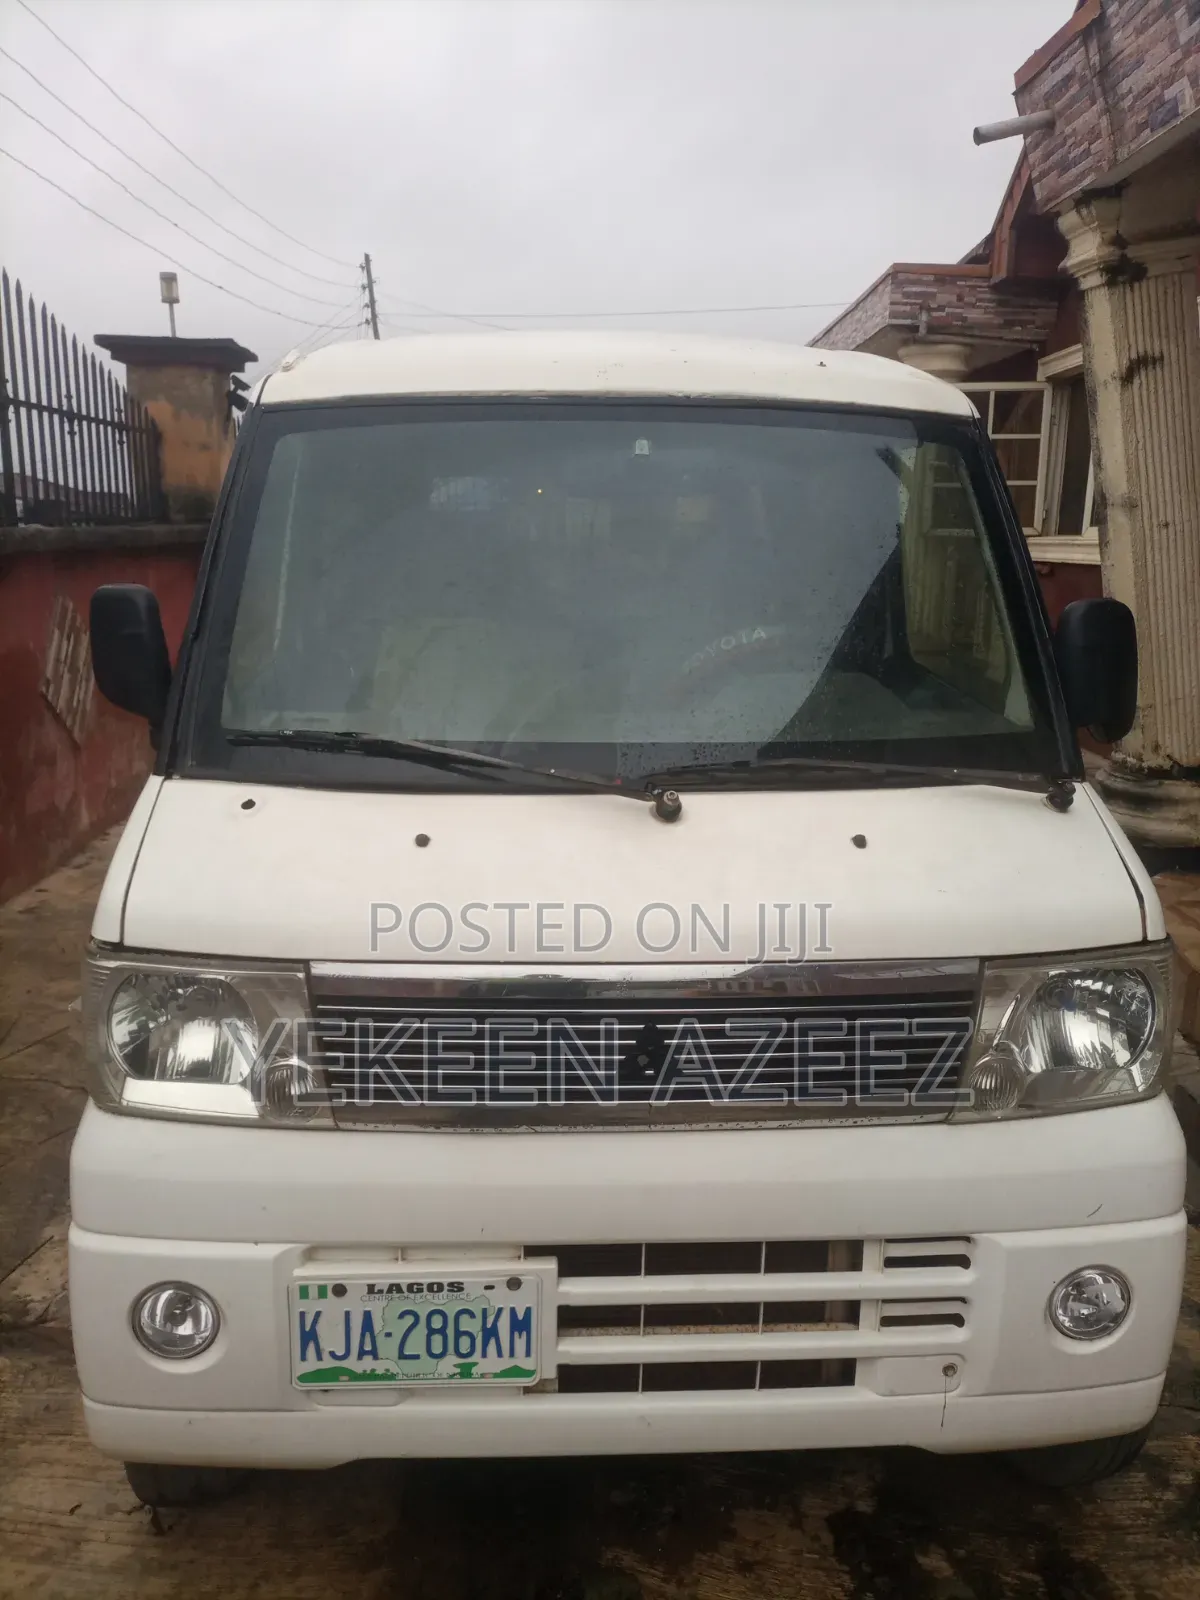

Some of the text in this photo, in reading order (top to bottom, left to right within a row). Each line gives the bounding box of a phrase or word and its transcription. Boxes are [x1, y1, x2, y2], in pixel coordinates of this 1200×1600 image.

[366, 1281, 465, 1295] LAGOS
[360, 1294, 396, 1303] CENTRE
[413, 1292, 471, 1302] EXCELLENCE
[299, 1306, 532, 1362] KJA-286KM
